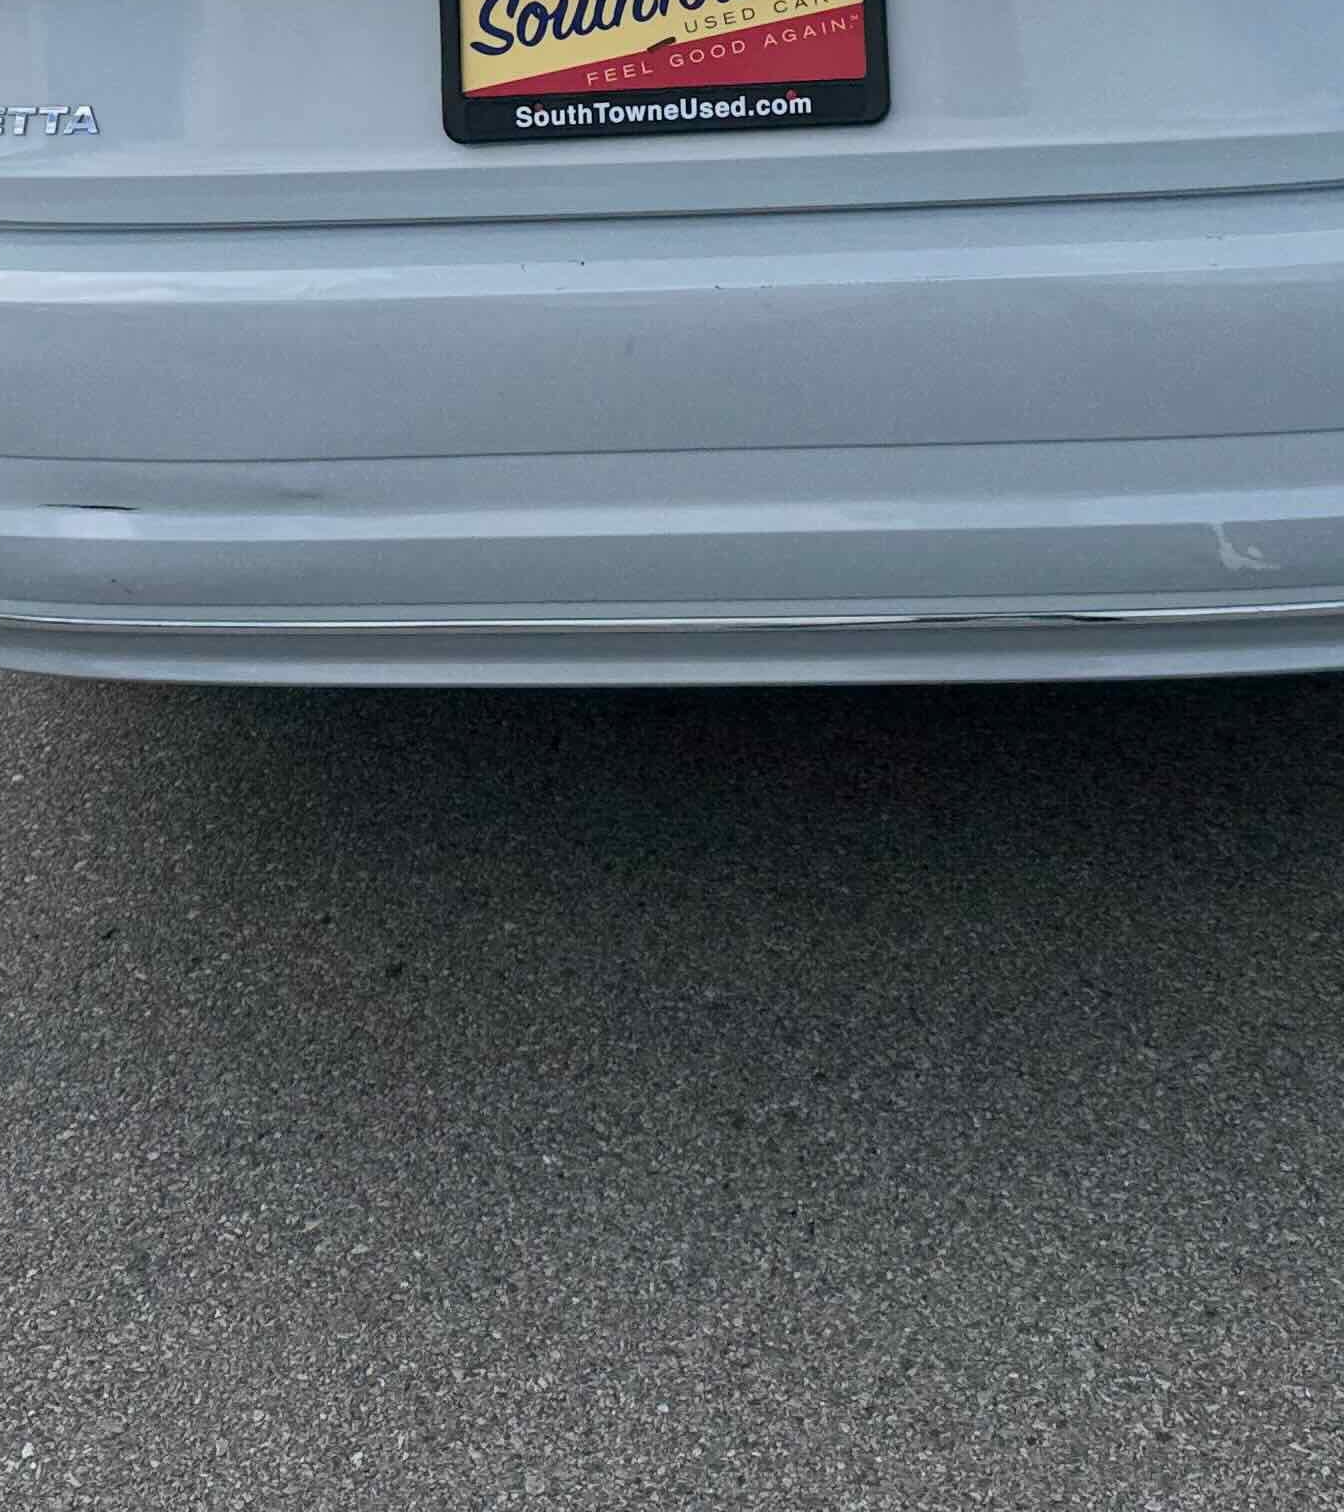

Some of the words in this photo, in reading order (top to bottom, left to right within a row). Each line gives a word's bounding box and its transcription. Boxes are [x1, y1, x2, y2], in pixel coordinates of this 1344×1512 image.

[683, 7, 756, 34] USED
[585, 60, 654, 86] FEEL
[668, 39, 747, 68] GOOD
[515, 96, 813, 129] SouthTowneUsed.com
